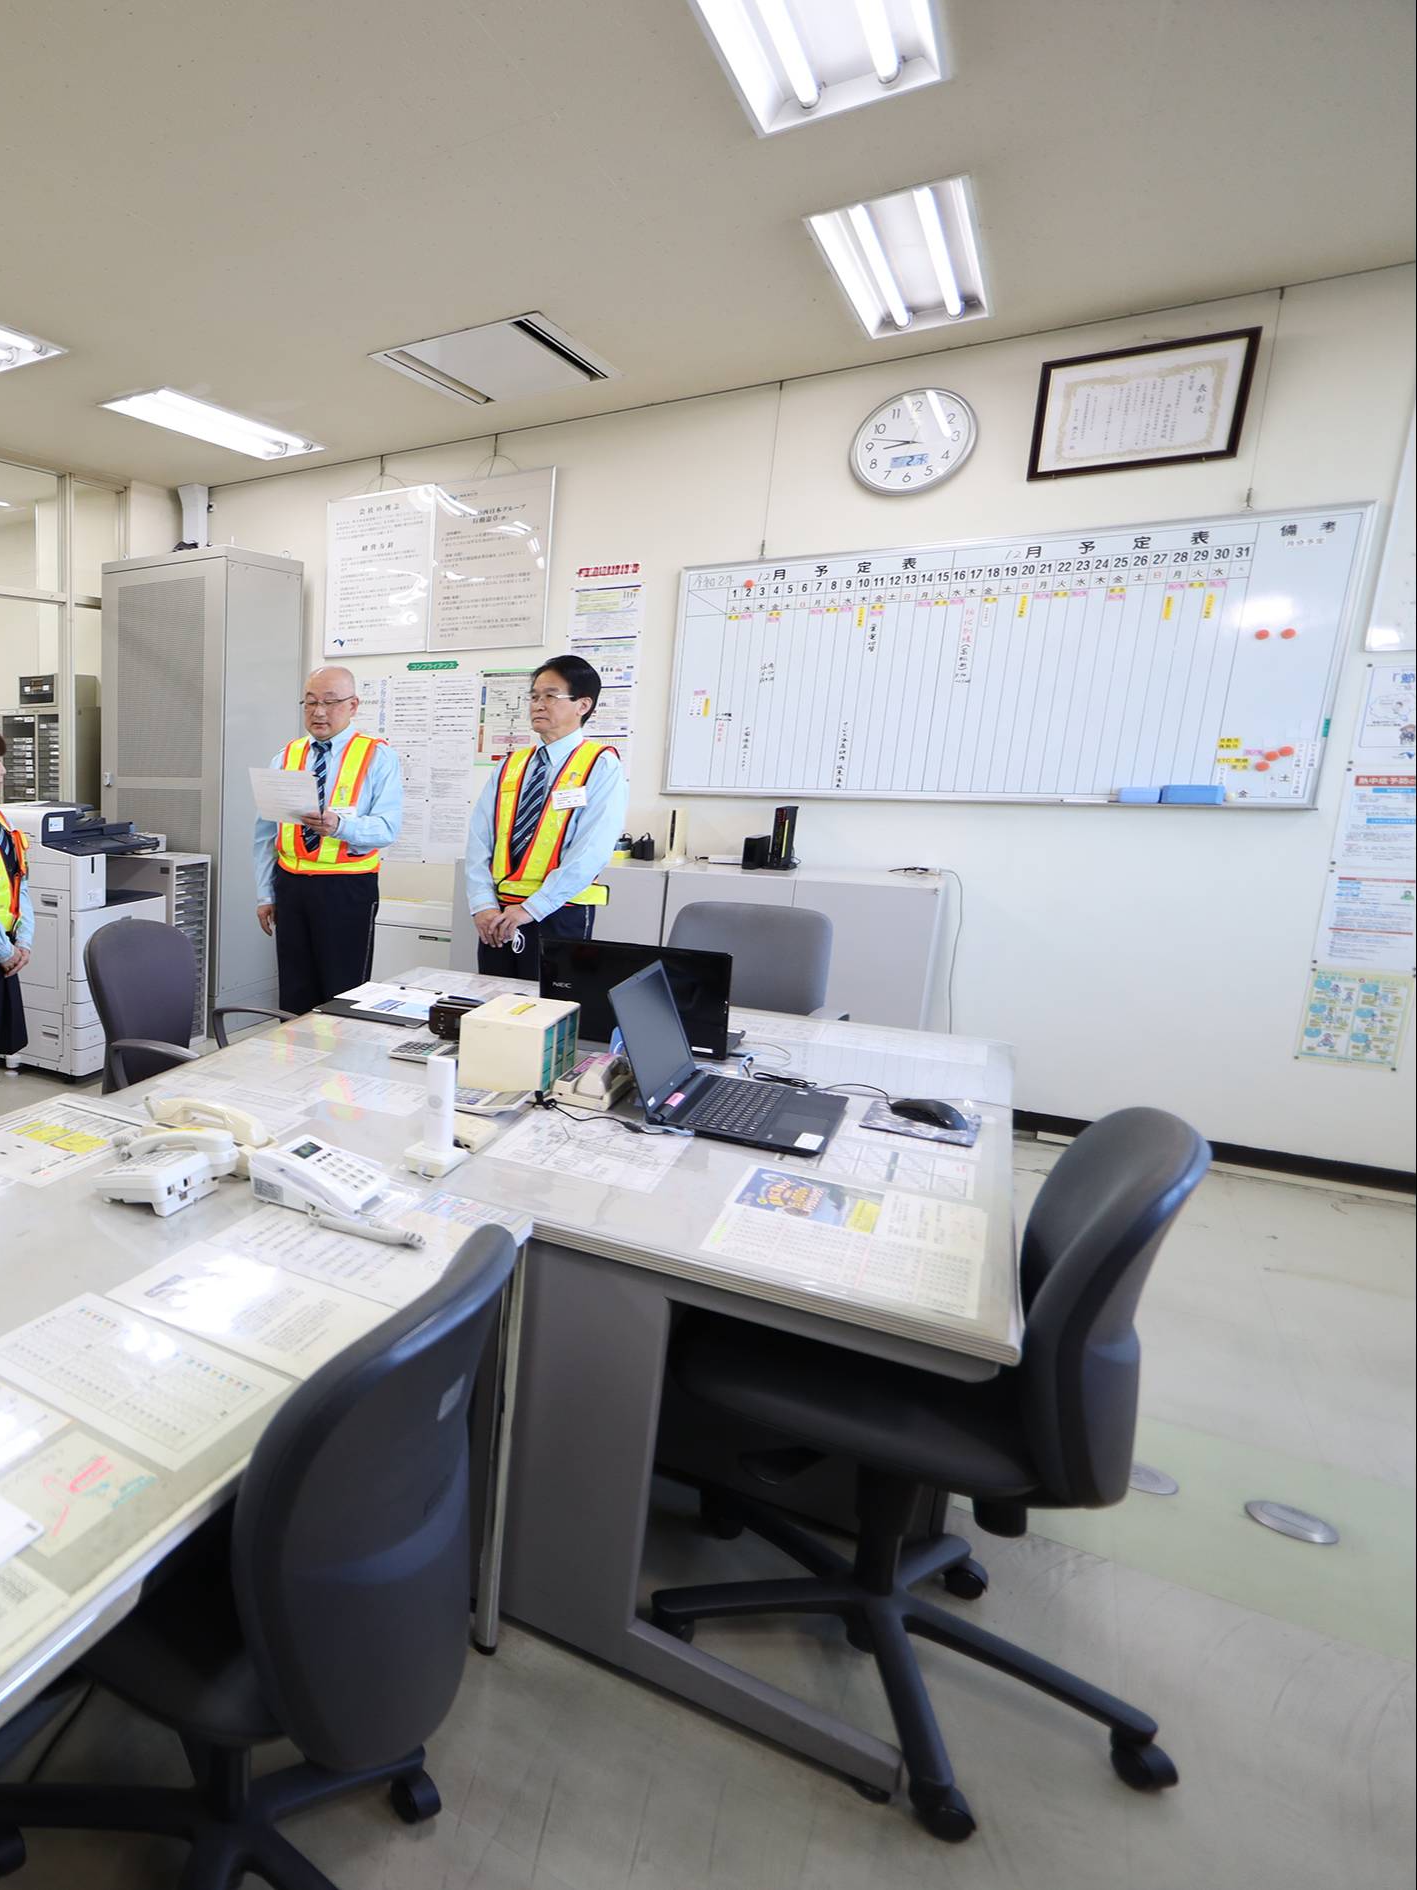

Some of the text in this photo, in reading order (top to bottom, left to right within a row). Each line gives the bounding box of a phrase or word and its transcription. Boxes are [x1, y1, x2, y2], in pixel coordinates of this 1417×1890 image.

[892, 408, 900, 420] 11
[947, 413, 956, 424] 2
[874, 424, 886, 434] 10
[951, 430, 960, 441] 3
[865, 442, 874, 453] 9
[941, 450, 949, 459] 4
[870, 459, 877, 469] 8
[884, 470, 891, 480] 7
[924, 465, 933, 476] 5
[902, 472, 911, 483] 6
[745, 589, 751, 597] 2
[759, 587, 765, 596] 3
[788, 585, 793, 593] 5
[802, 584, 808, 592] 6
[816, 582, 822, 591] 7
[831, 581, 837, 590] 8
[845, 580, 852, 589] 9
[859, 579, 870, 588] 10
[874, 577, 884, 586] 11
[889, 576, 901, 585] 12
[905, 575, 917, 584] 13
[920, 573, 933, 583] 14
[937, 571, 949, 582] 15
[953, 570, 966, 580] 16
[970, 569, 982, 580] 17
[987, 567, 1000, 578] 18
[1004, 566, 1018, 577] 19
[1022, 564, 1035, 575] 20
[1039, 563, 1052, 574] 21
[1057, 562, 1072, 573] 22
[1076, 560, 1090, 571] 23
[1095, 558, 1109, 570] 24
[1114, 557, 1128, 568] 25
[1134, 555, 1148, 566] 26
[1153, 553, 1168, 565] 27
[1173, 552, 1188, 563] 28
[1193, 550, 1208, 562] 29
[1214, 548, 1230, 559] 30
[1235, 547, 1250, 558] 31
